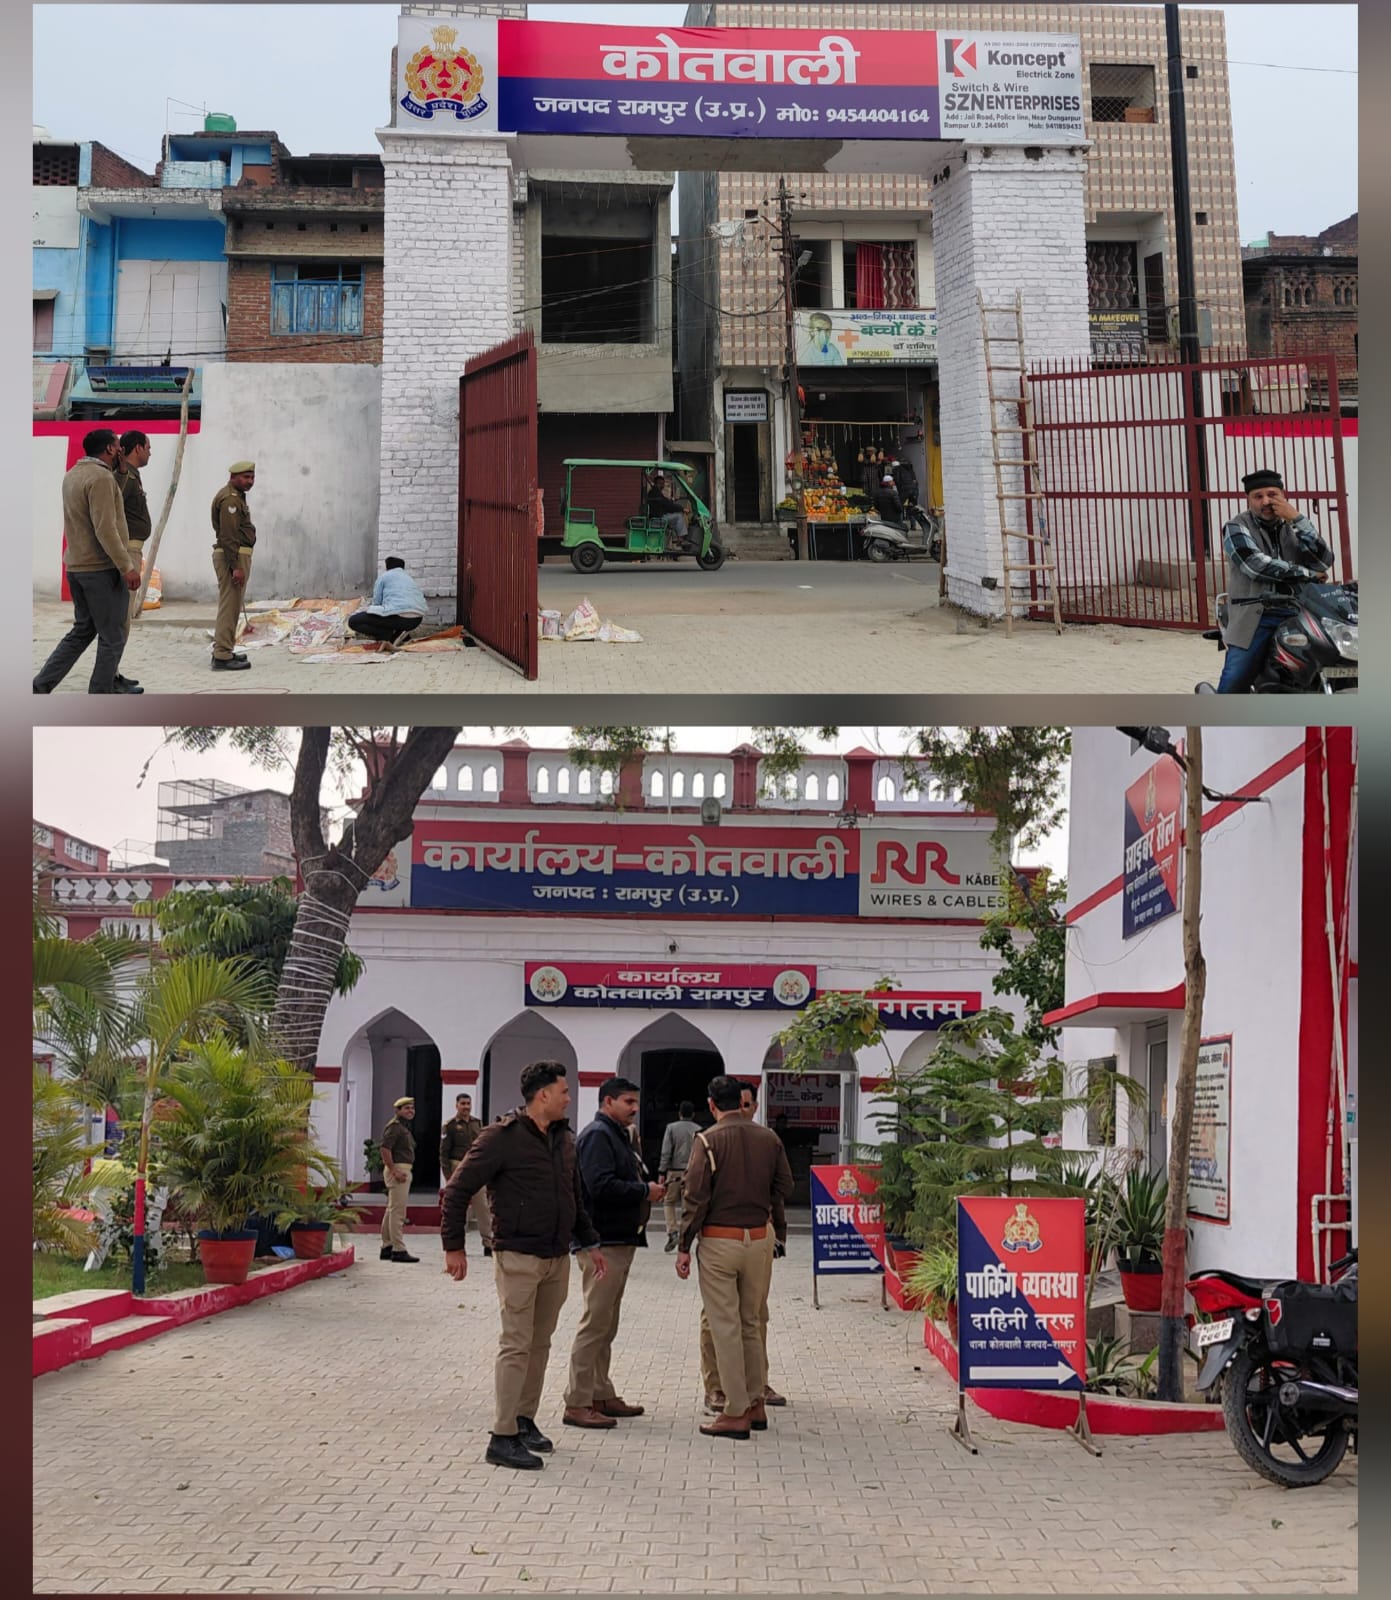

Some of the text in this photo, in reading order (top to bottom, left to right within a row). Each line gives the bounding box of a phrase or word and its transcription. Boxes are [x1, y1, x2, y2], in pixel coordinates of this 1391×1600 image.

[599, 33, 861, 85] कोतवाली
[988, 50, 1066, 69] Koncept
[1017, 71, 1075, 79] Electrick Zone
[952, 83, 1029, 92] Switch & Wire
[533, 97, 612, 114] जनपद
[617, 99, 688, 125] रामपुर
[694, 95, 767, 123] (उ.प्र.)
[826, 108, 930, 123] 9454404164
[860, 321, 904, 336] बच्चों
[906, 321, 926, 336] के
[1126, 810, 1176, 875] साइबर सेल
[870, 841, 960, 885] RR
[532, 885, 597, 899] जनपद
[615, 887, 674, 907] रामपुर
[679, 884, 740, 907] (उ.प्र.)
[870, 894, 922, 906] WIRES
[927, 895, 937, 906] &
[617, 968, 722, 984] कार्यालय
[574, 984, 766, 1007] कोतवाली रामपुर
[815, 1204, 855, 1228] साइबर
[966, 1264, 1079, 1299] पार्किंग व्यवस्था
[970, 1307, 1075, 1332] दाहिनी तरफ
